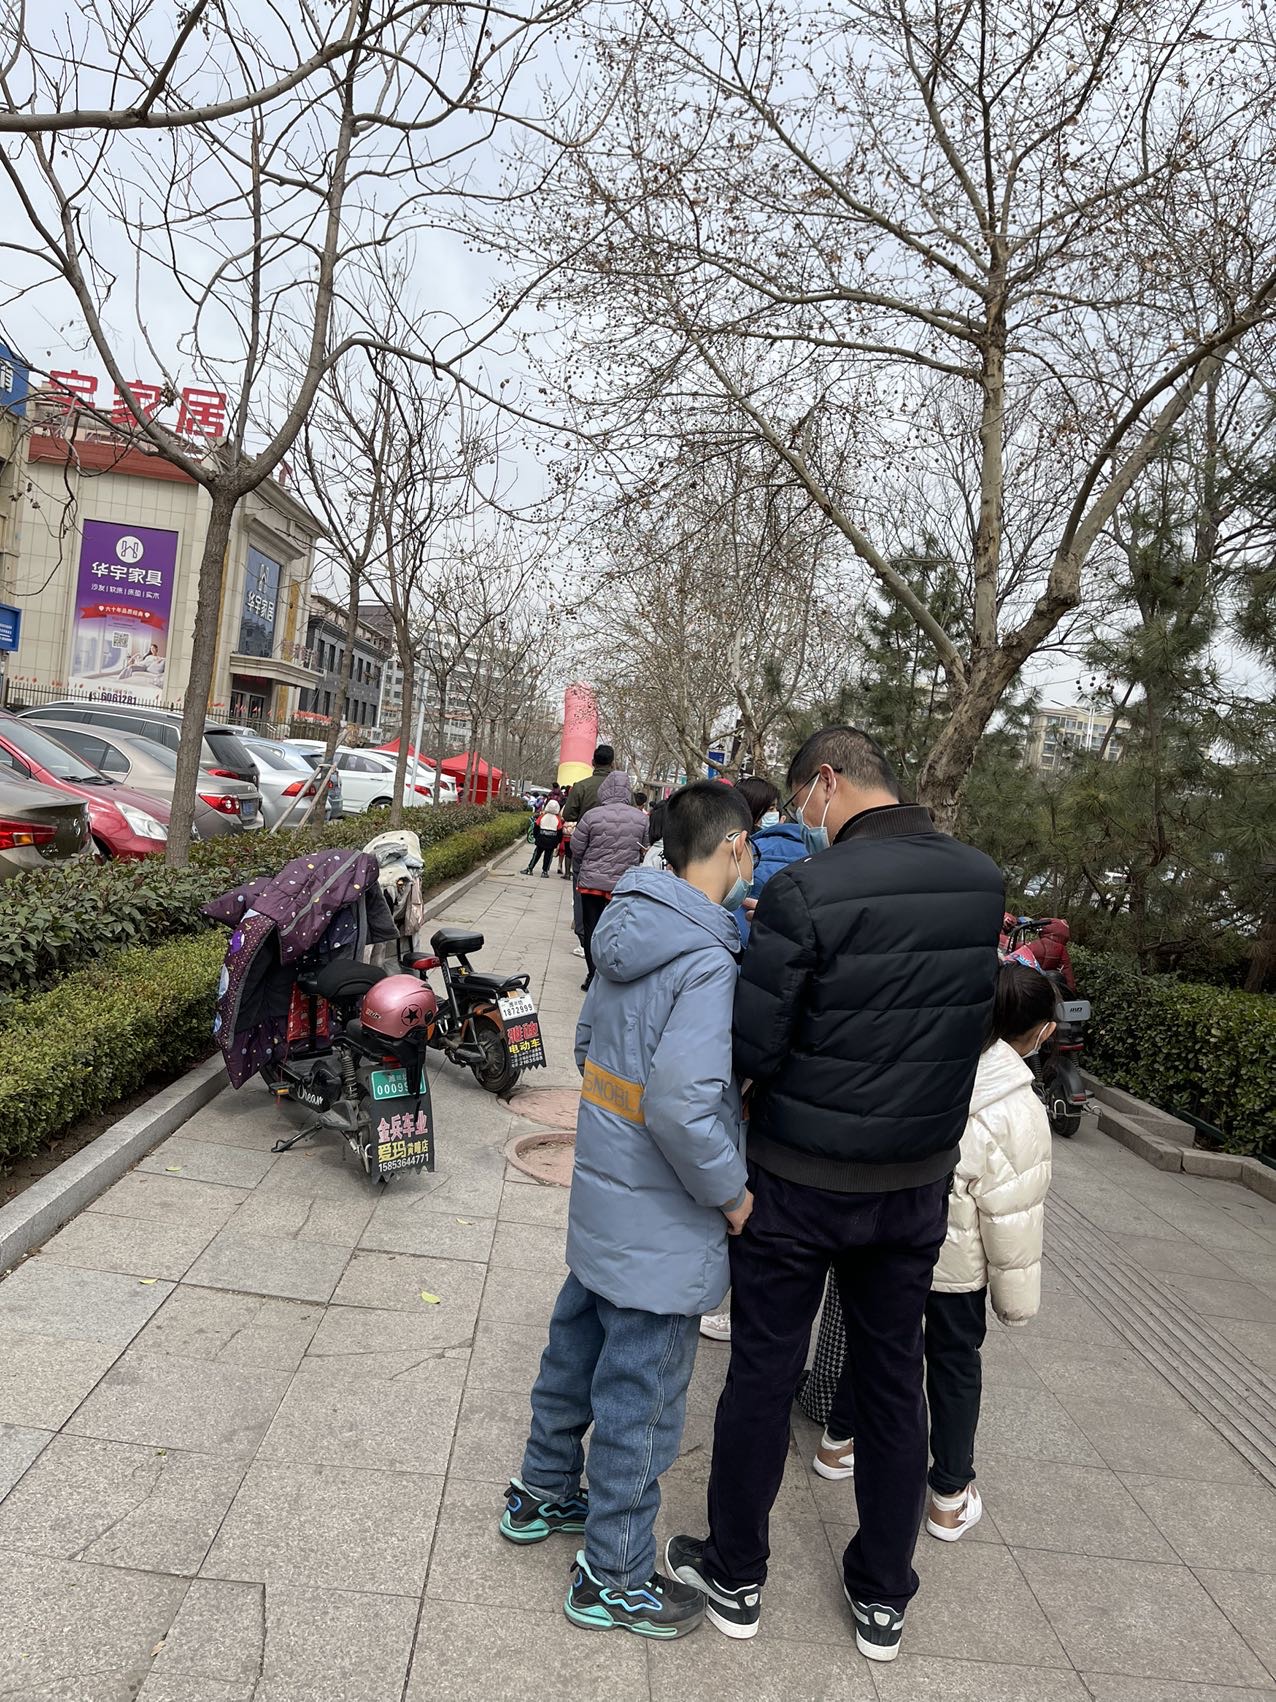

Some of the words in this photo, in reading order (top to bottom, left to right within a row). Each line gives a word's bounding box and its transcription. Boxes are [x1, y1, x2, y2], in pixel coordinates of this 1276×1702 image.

[91, 561, 162, 587] 华宇家具
[247, 590, 275, 622] 华宇家居
[503, 1003, 533, 1017] 1872999
[509, 1038, 541, 1054] 电动车
[377, 1110, 428, 1143] 金兵车业
[378, 1153, 429, 1172] 15853644771
